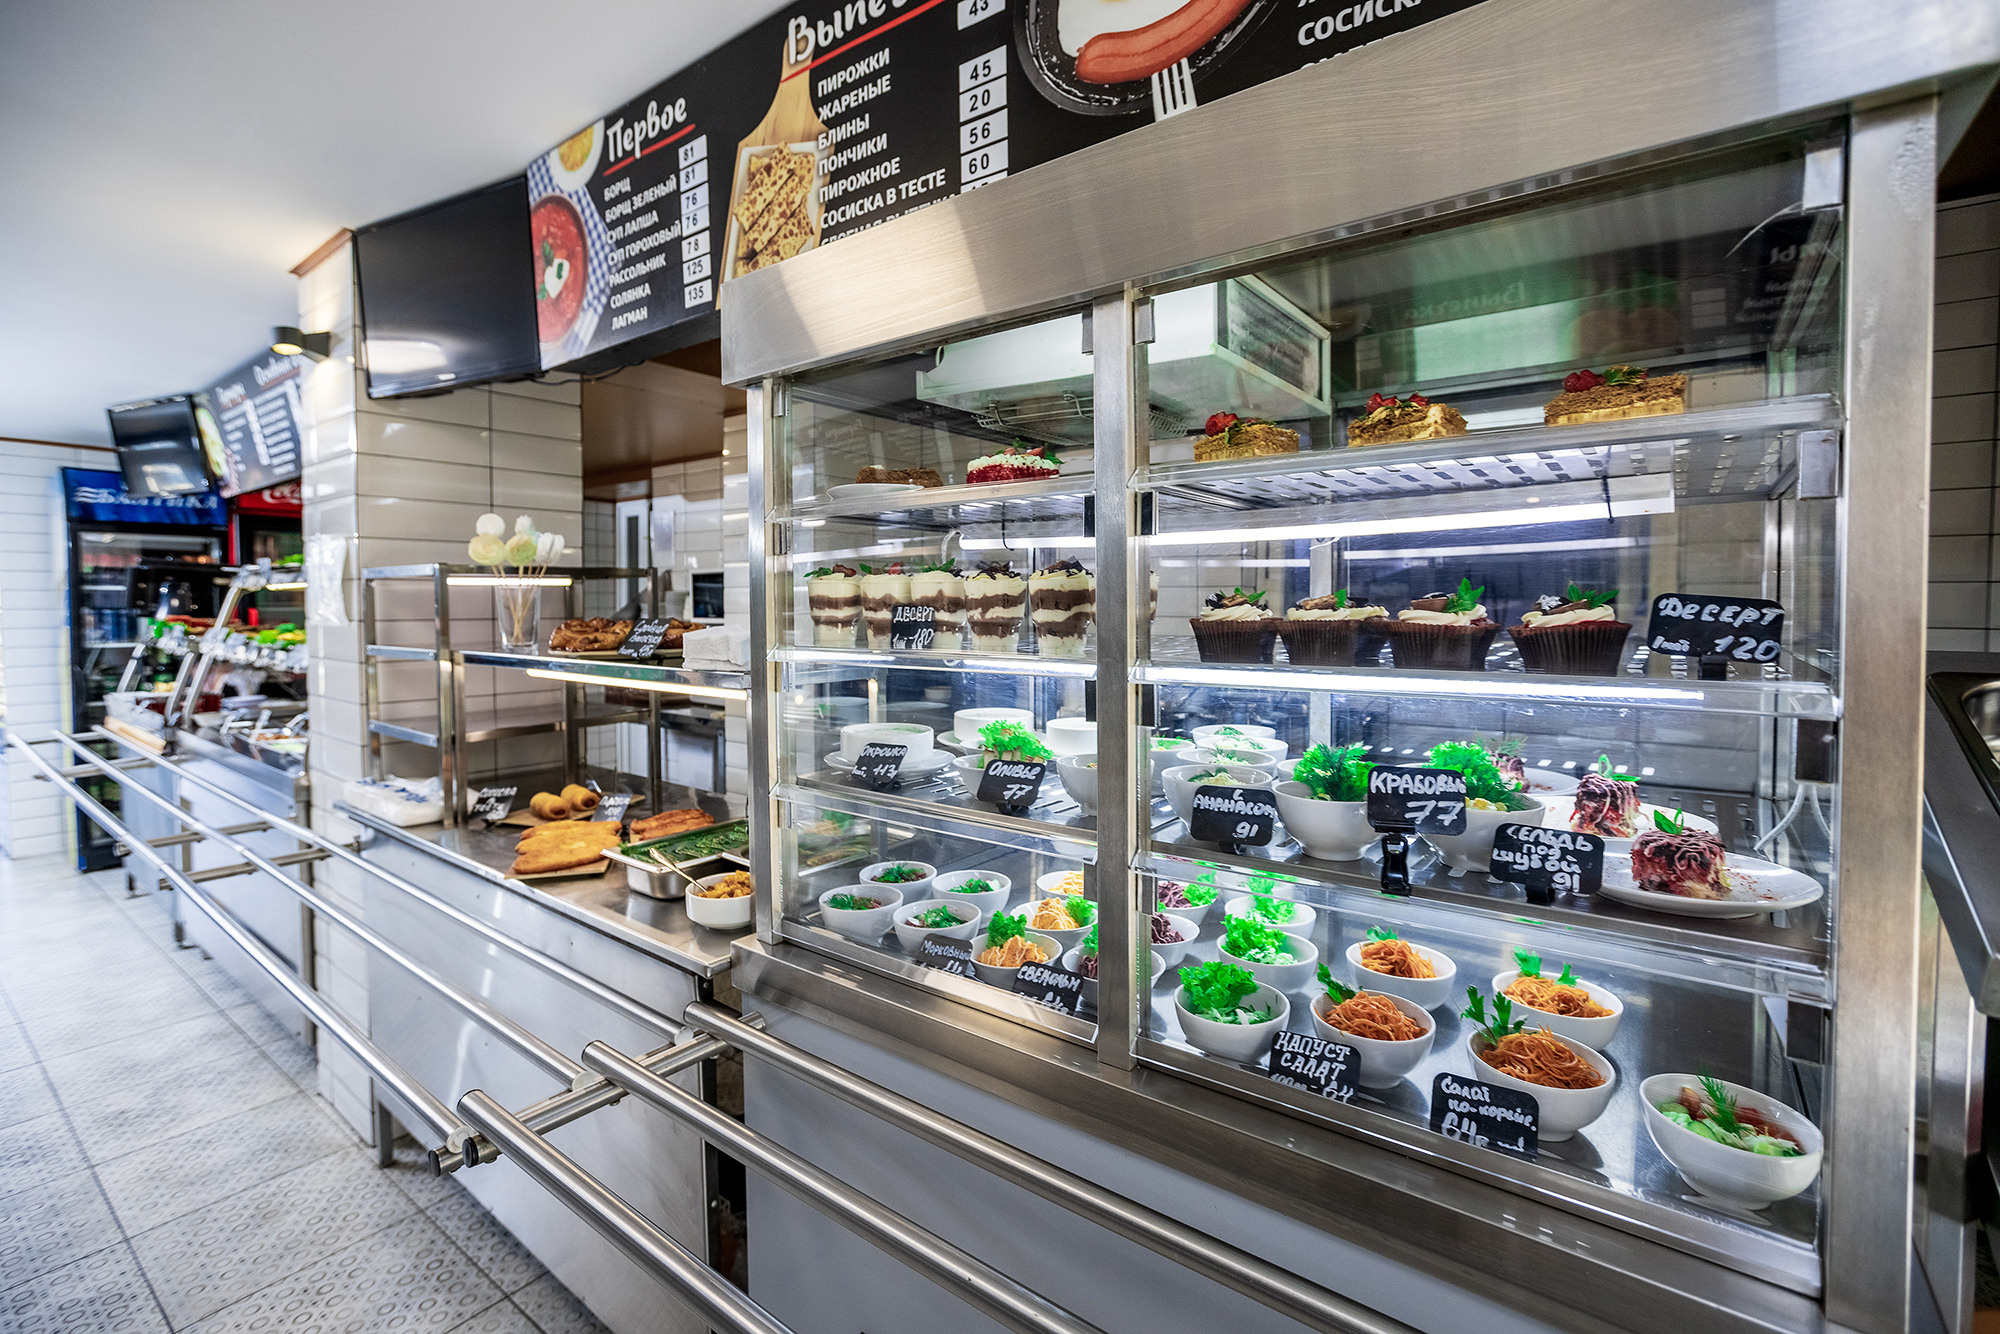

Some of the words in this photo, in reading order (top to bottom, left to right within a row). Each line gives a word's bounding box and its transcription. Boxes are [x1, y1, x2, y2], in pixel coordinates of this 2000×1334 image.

[817, 47, 891, 98] ПИРОЖКИ
[969, 59, 992, 82] 45
[817, 74, 892, 123] ЖАРЕНЫЕ
[968, 89, 991, 112] 20
[606, 97, 688, 162] Первое
[817, 113, 870, 150] БЛИНЫ
[969, 122, 991, 145] 56
[683, 144, 695, 162] 81
[818, 133, 888, 176] ПОНЧИКИ
[968, 153, 990, 175] 60
[684, 167, 696, 184] 81
[818, 157, 901, 203] ПИРОЖНОЕ
[603, 176, 632, 202] БОРЩ
[604, 199, 633, 224] БОРЩ
[632, 173, 678, 211] ЗЕЛЕНЫЙ
[685, 192, 698, 210] 76
[820, 194, 884, 229] СОСИСКА
[886, 187, 897, 206] В
[898, 168, 947, 200] ТЕСТЕ
[606, 225, 624, 245] СУП
[624, 209, 660, 238] ЛАПША
[685, 213, 698, 230] 76
[607, 248, 626, 267] СУП
[625, 219, 682, 259] ГОРОХОВЫЙ
[687, 238, 700, 255] 78
[608, 252, 667, 288] РАССОЛЬНИК
[687, 260, 704, 277] 125
[610, 282, 652, 309] СОЛЯНКА
[688, 285, 704, 302] 135
[611, 305, 649, 331] ЛАГМАН
[1714, 635, 1782, 662] 120
[1002, 784, 1034, 800] 77
[1404, 800, 1465, 826] 77
[1232, 821, 1259, 839] 91
[1551, 872, 1580, 893] 91
[1274, 1032, 1351, 1062] КАПУСТ
[1280, 1052, 1347, 1085] САЛАТ
